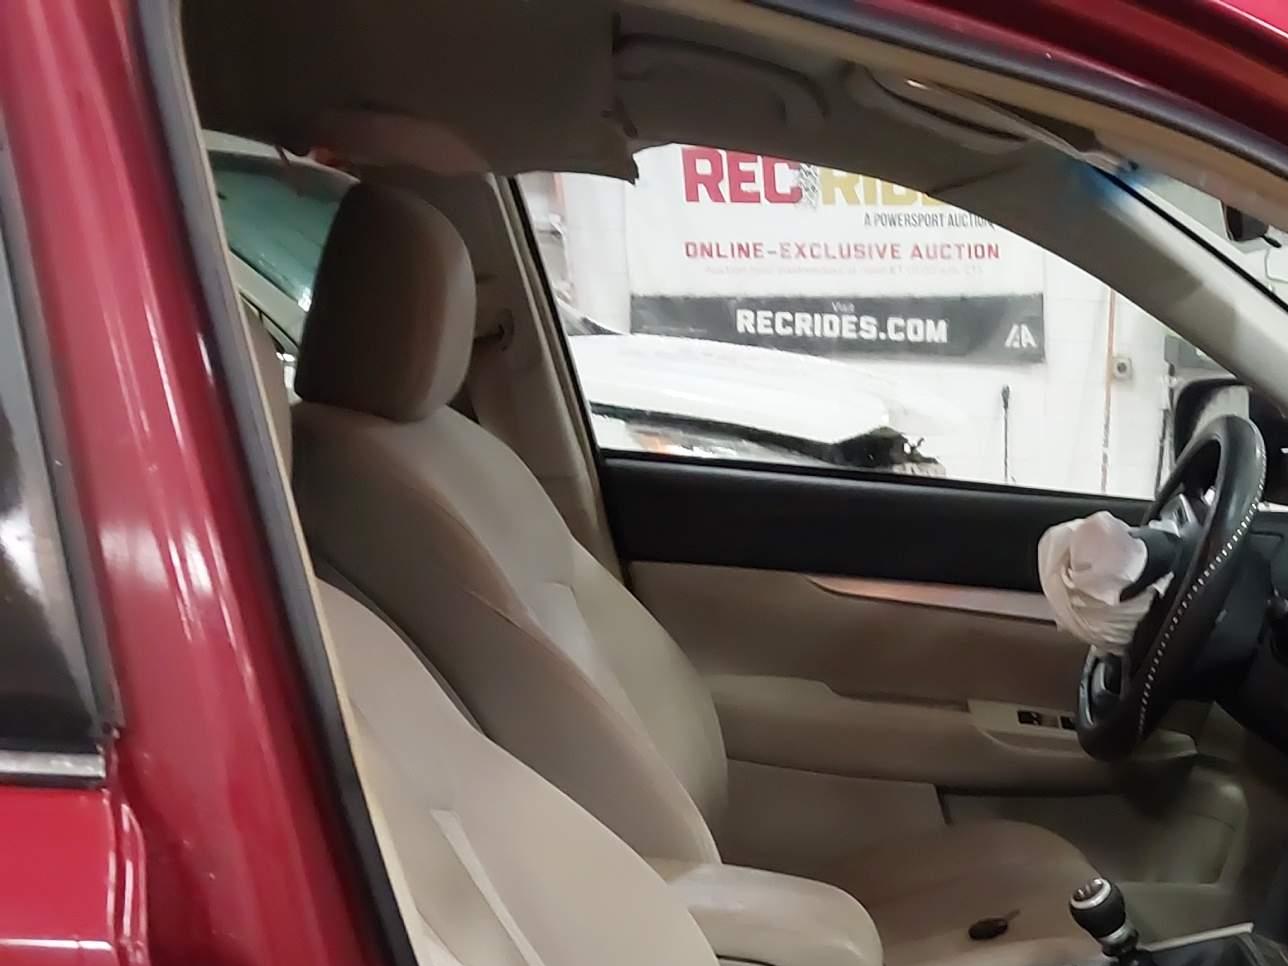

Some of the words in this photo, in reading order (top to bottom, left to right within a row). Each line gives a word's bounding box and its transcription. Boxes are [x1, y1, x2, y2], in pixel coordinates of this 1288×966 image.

[682, 146, 803, 203] REC
[820, 166, 946, 206] RI
[864, 213, 872, 227] A
[873, 213, 944, 229] POWERSPORT
[684, 241, 902, 260] ONLINE-EXCLUSIVE
[911, 243, 1000, 260] AUCTION
[735, 308, 949, 344] RECRIDES.COM
